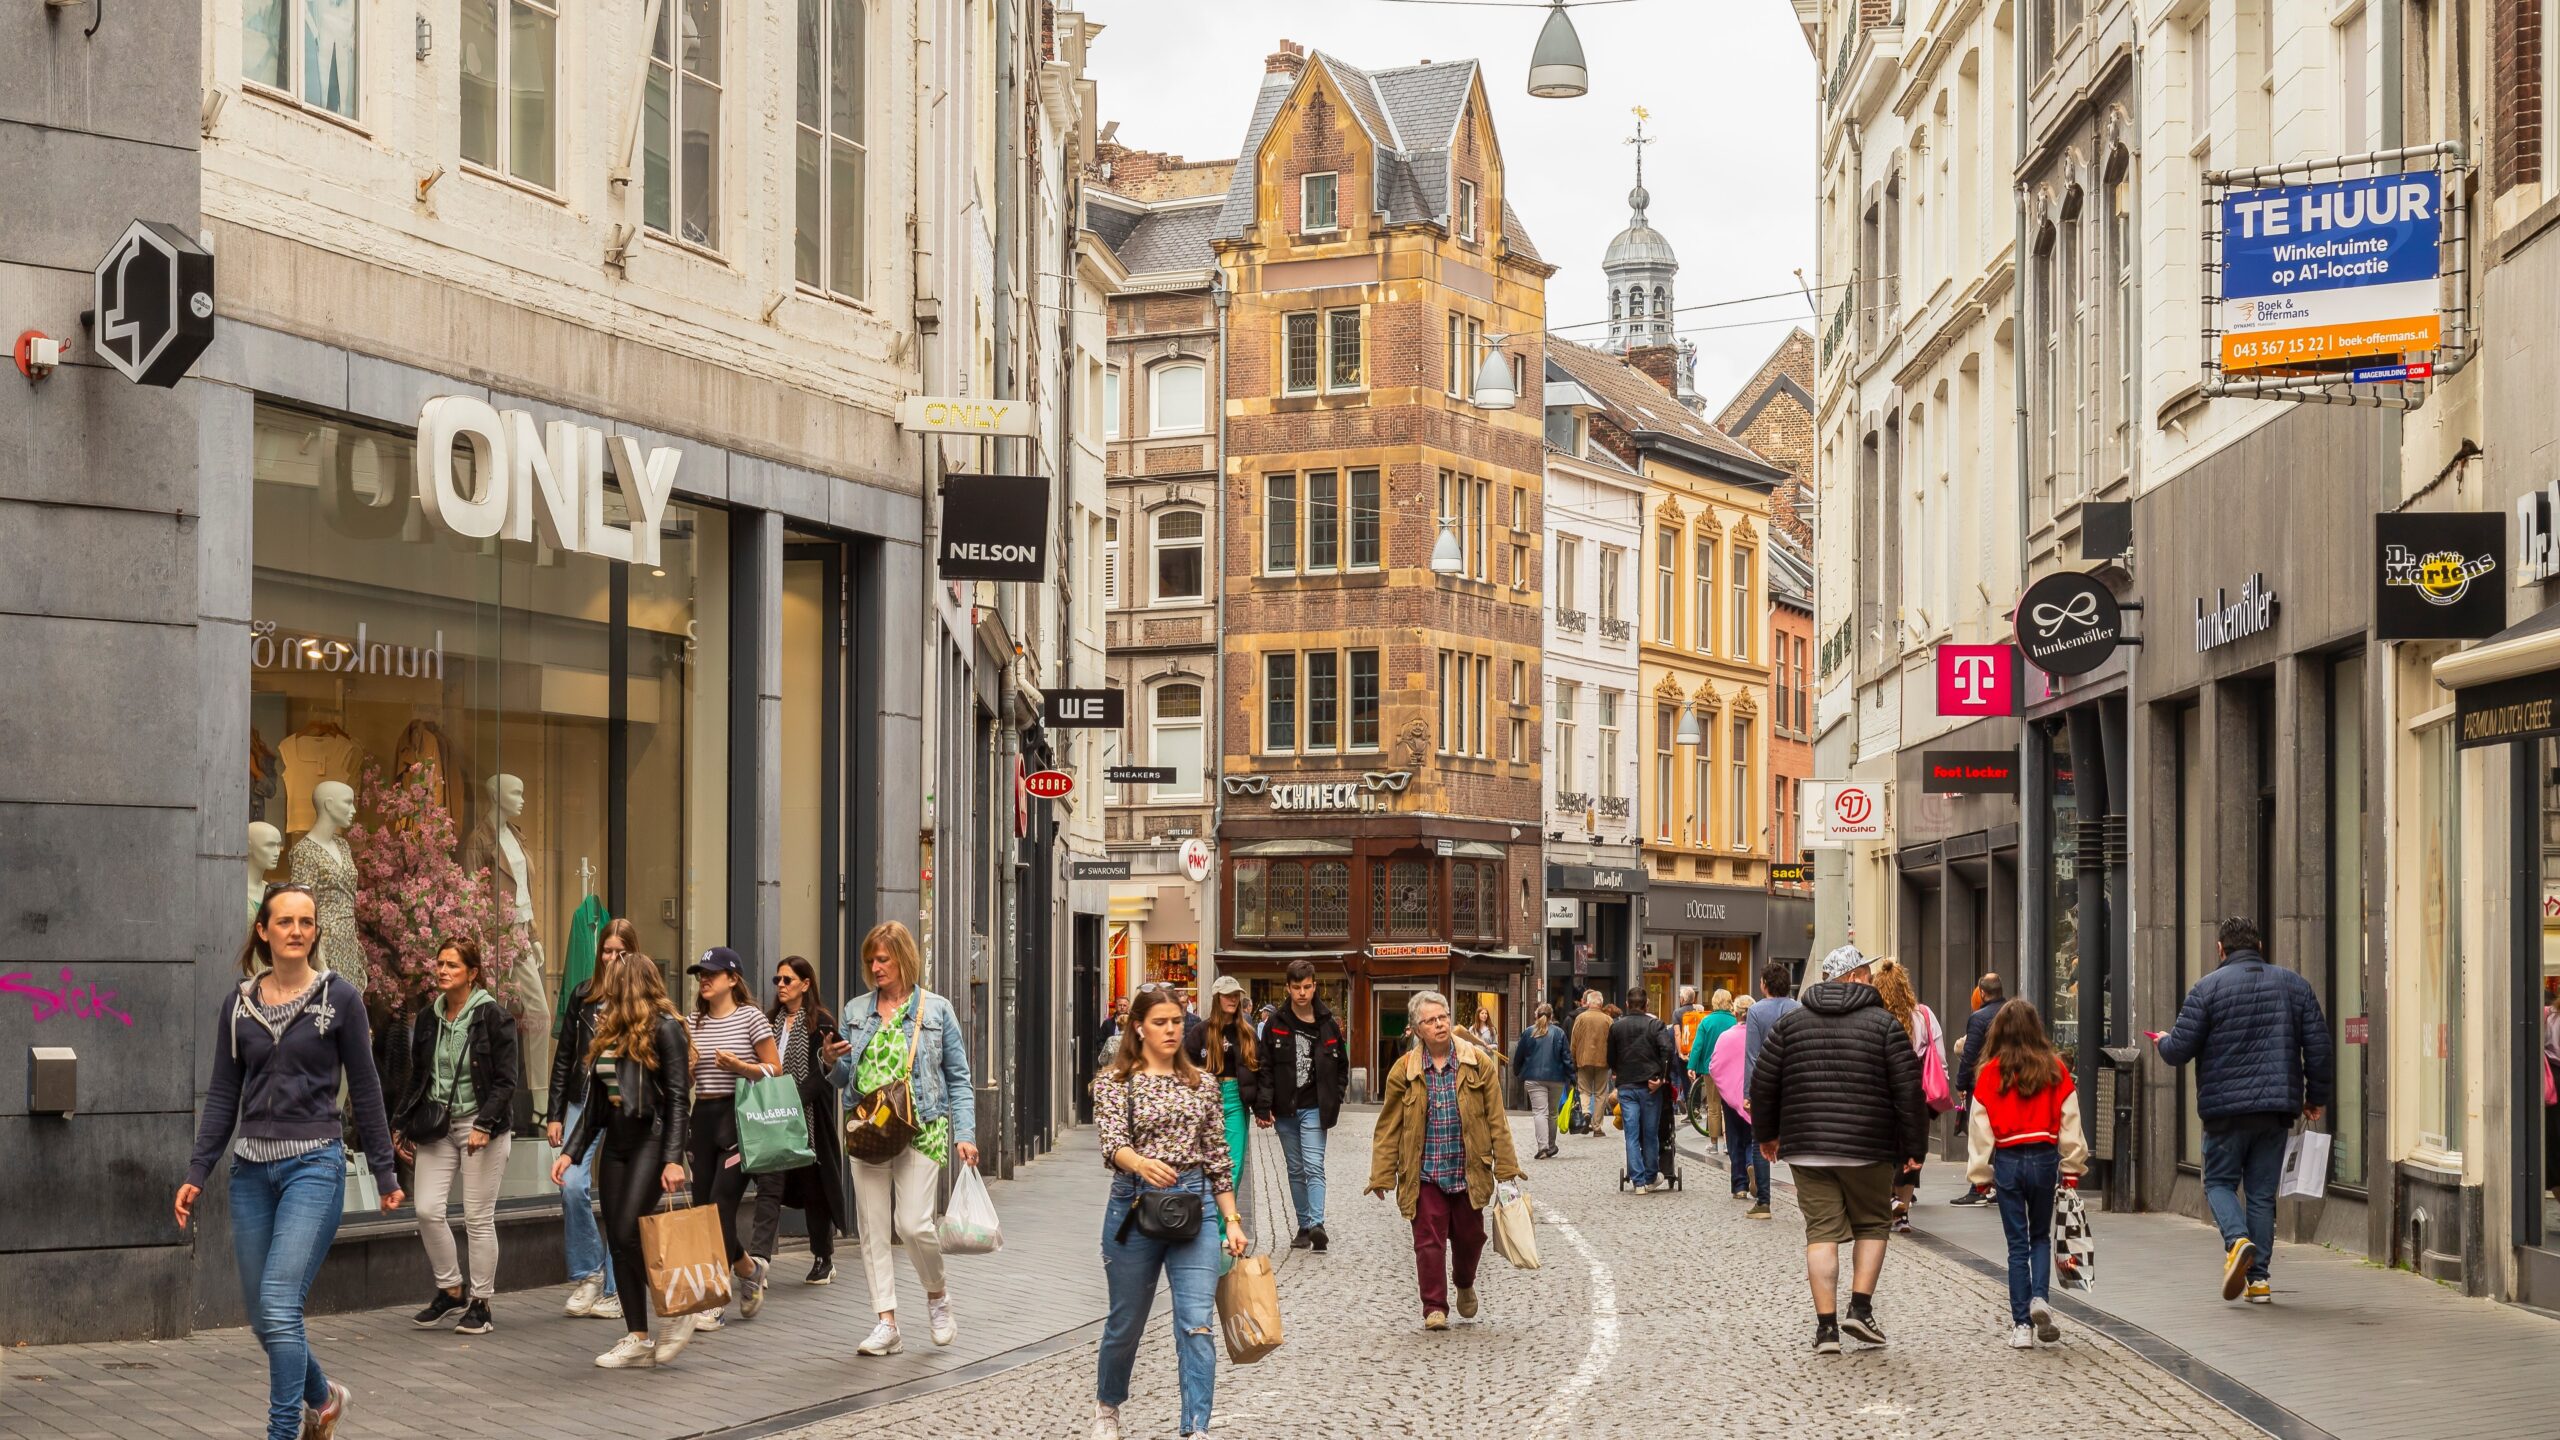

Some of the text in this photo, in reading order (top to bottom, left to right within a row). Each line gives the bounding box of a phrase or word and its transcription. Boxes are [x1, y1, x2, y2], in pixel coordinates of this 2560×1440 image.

[2234, 183, 2431, 239] TE HUUR
[2272, 237, 2388, 262] Winkelruimte
[2271, 257, 2389, 287] op A1-locatie
[2257, 299, 2294, 311] Boek &
[2257, 309, 2310, 321] Offermans
[2233, 327, 2429, 358] 043 367 15 22 boek-offermans.nl
[925, 402, 1009, 430] ONLY
[416, 394, 683, 568] ONLY
[949, 542, 1037, 564] NELSON
[2385, 544, 2417, 566] Dr.
[2385, 553, 2497, 586] Martens
[2195, 572, 2273, 654] hunkemöller
[2032, 627, 2115, 658] hunkemöller
[1059, 698, 1104, 719] WE
[2463, 698, 2552, 741] PREMIUM DUTCH CHEESE
[1113, 771, 1161, 779] SNEAKERS
[1933, 765, 2009, 780] Foot Locker
[1030, 778, 1067, 791] SCORE
[1270, 783, 1360, 810] SCHMECK
[1087, 867, 1126, 875] SWAROVSKI
[1376, 946, 1412, 955] SCHMECK
[746, 1106, 799, 1122] PULL&BEAR
